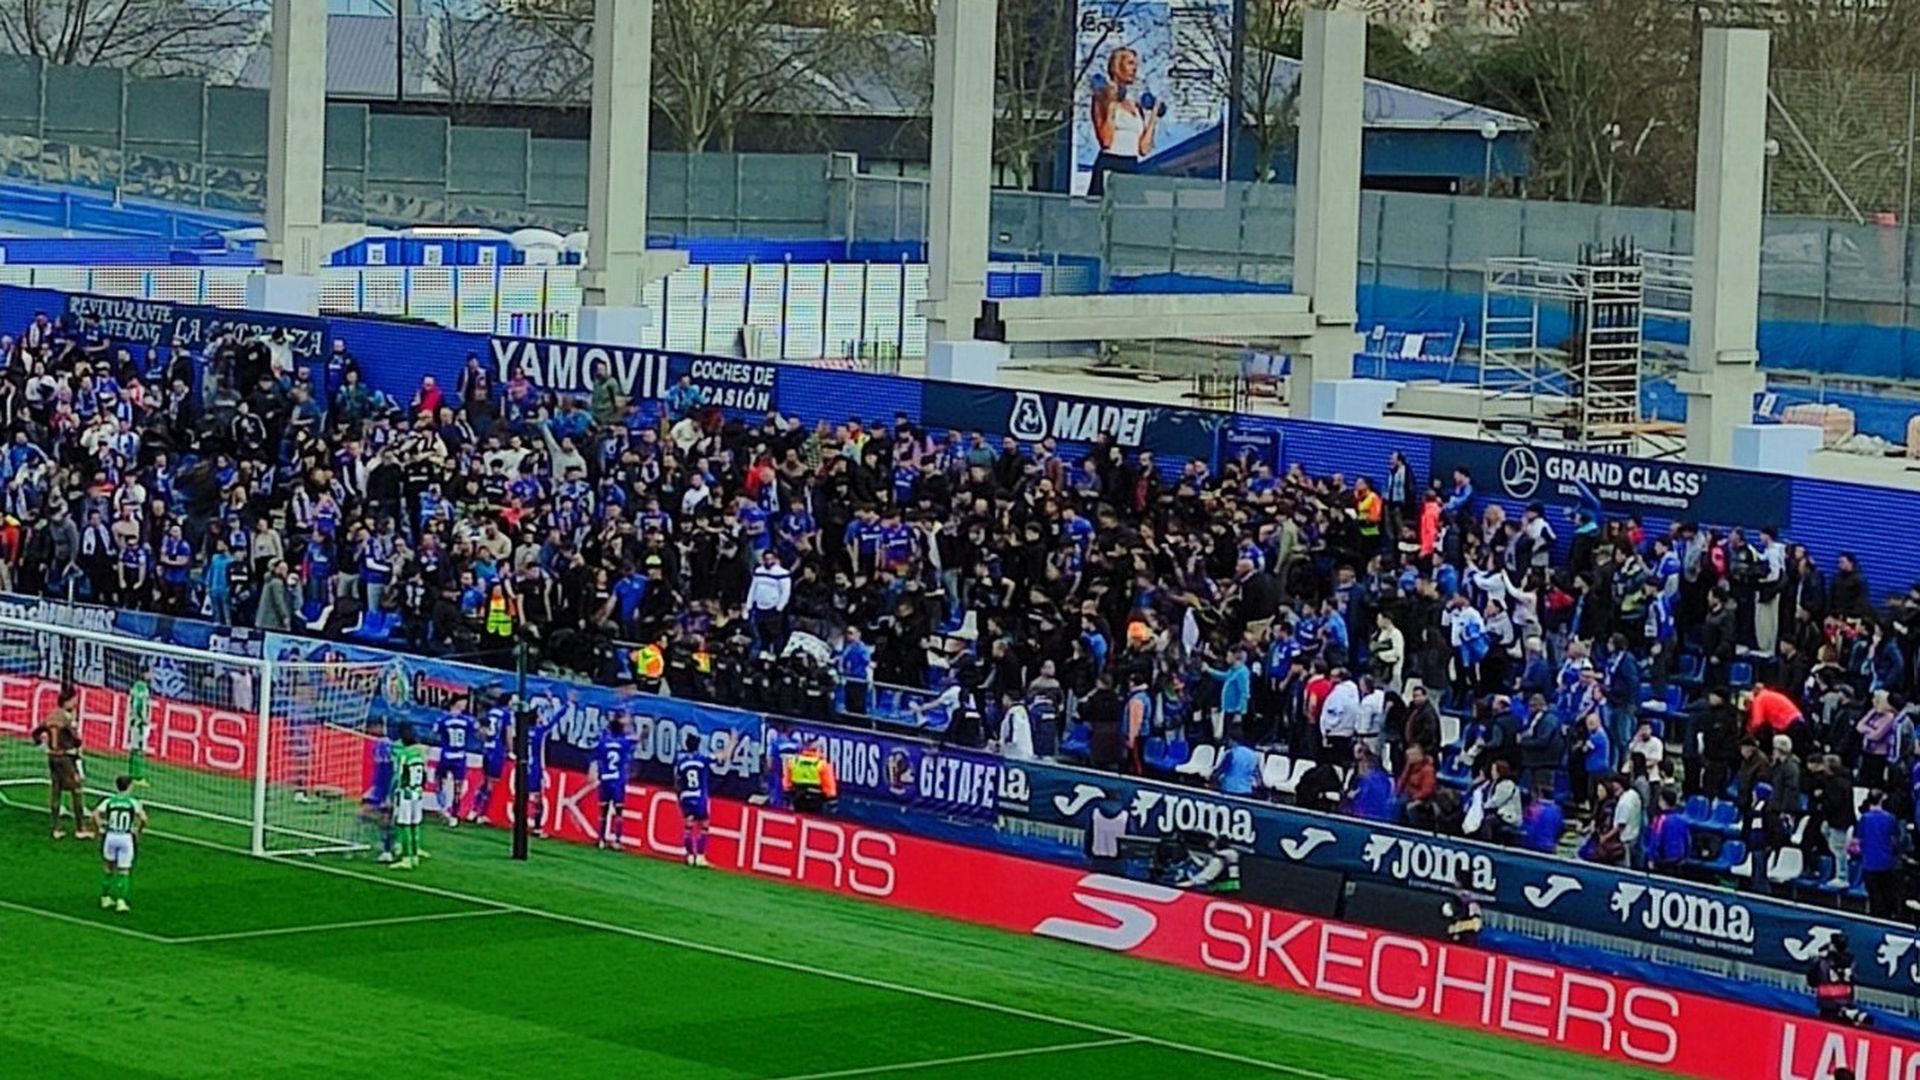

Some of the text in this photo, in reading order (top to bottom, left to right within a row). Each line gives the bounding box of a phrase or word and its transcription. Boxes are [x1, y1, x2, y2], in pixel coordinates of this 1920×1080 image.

[691, 360, 776, 386] COCHES DE
[1545, 456, 1700, 496] GRAND CLASS
[607, 751, 620, 770] 2
[686, 769, 699, 788] 8
[919, 756, 997, 808] GETAFE
[1200, 900, 1680, 1065] SKECHERS
